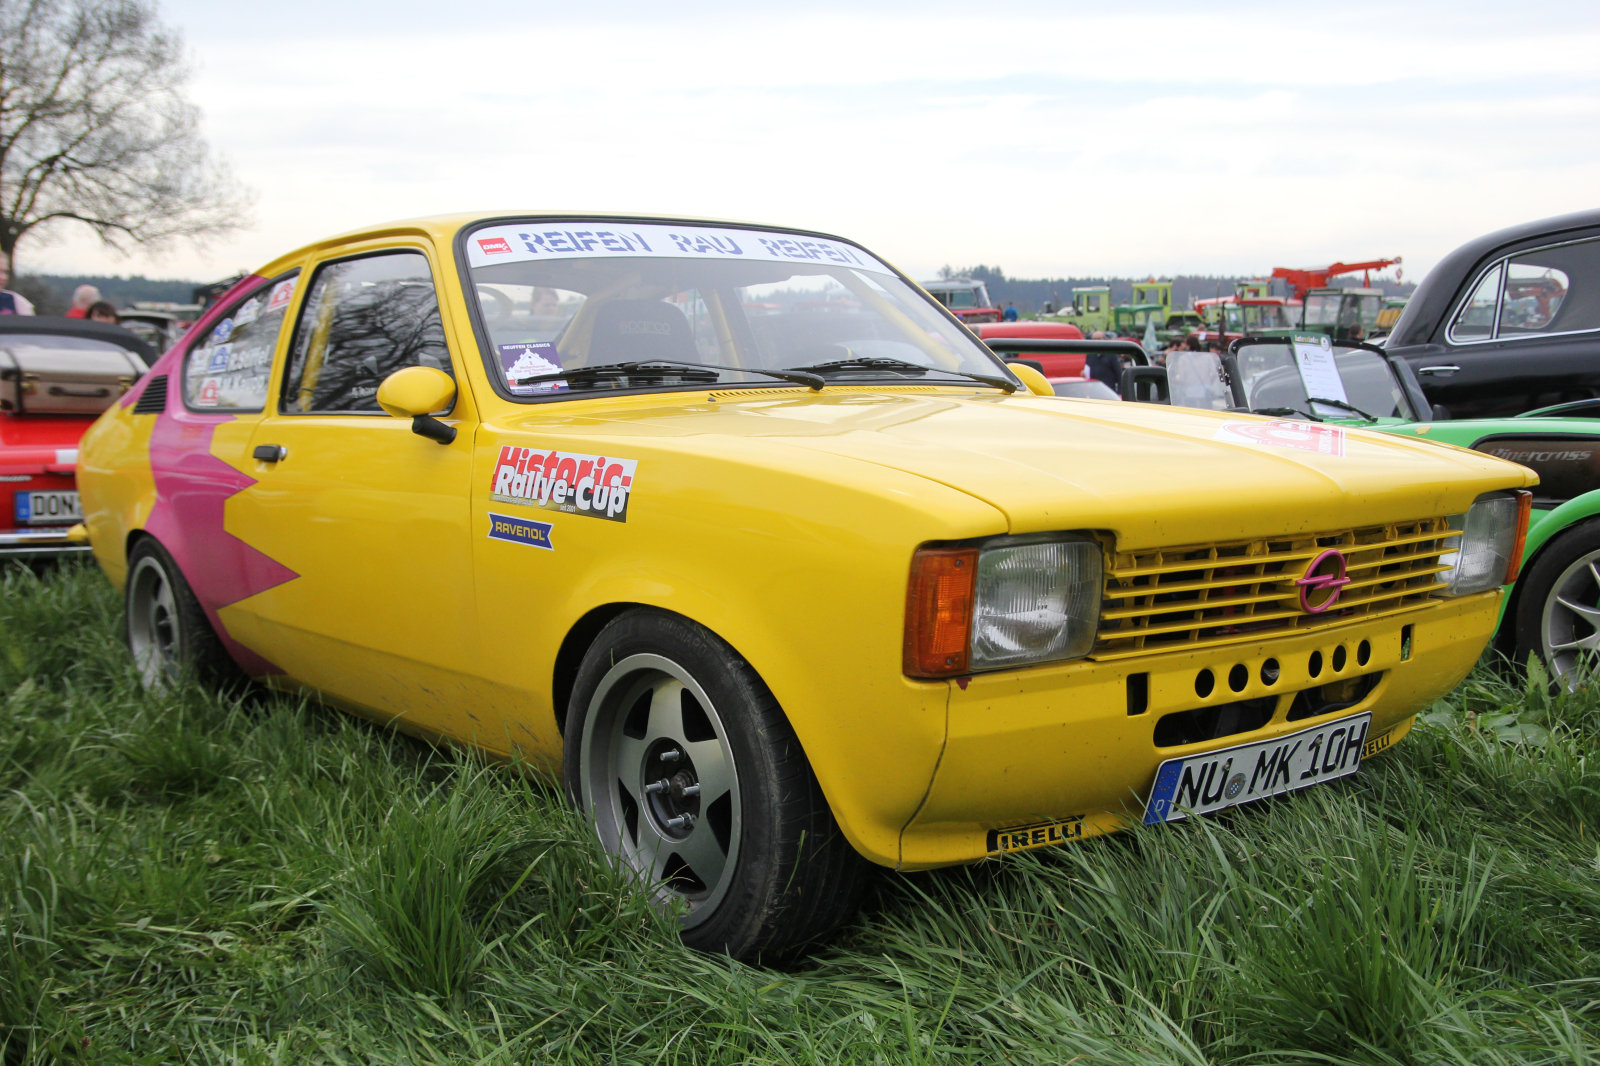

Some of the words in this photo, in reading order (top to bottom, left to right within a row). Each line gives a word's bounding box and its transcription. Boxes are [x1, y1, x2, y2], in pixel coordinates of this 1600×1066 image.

[517, 231, 653, 253] REIFEN
[668, 233, 743, 255] RAU
[757, 238, 865, 266] REIFEN
[620, 321, 670, 333] sparco
[494, 464, 627, 517] Rallye-Cup
[33, 495, 74, 515] DON
[495, 521, 545, 541] RAVENOL
[1172, 757, 1234, 812] NU
[1247, 739, 1303, 795] MK
[1300, 722, 1368, 780] 10H
